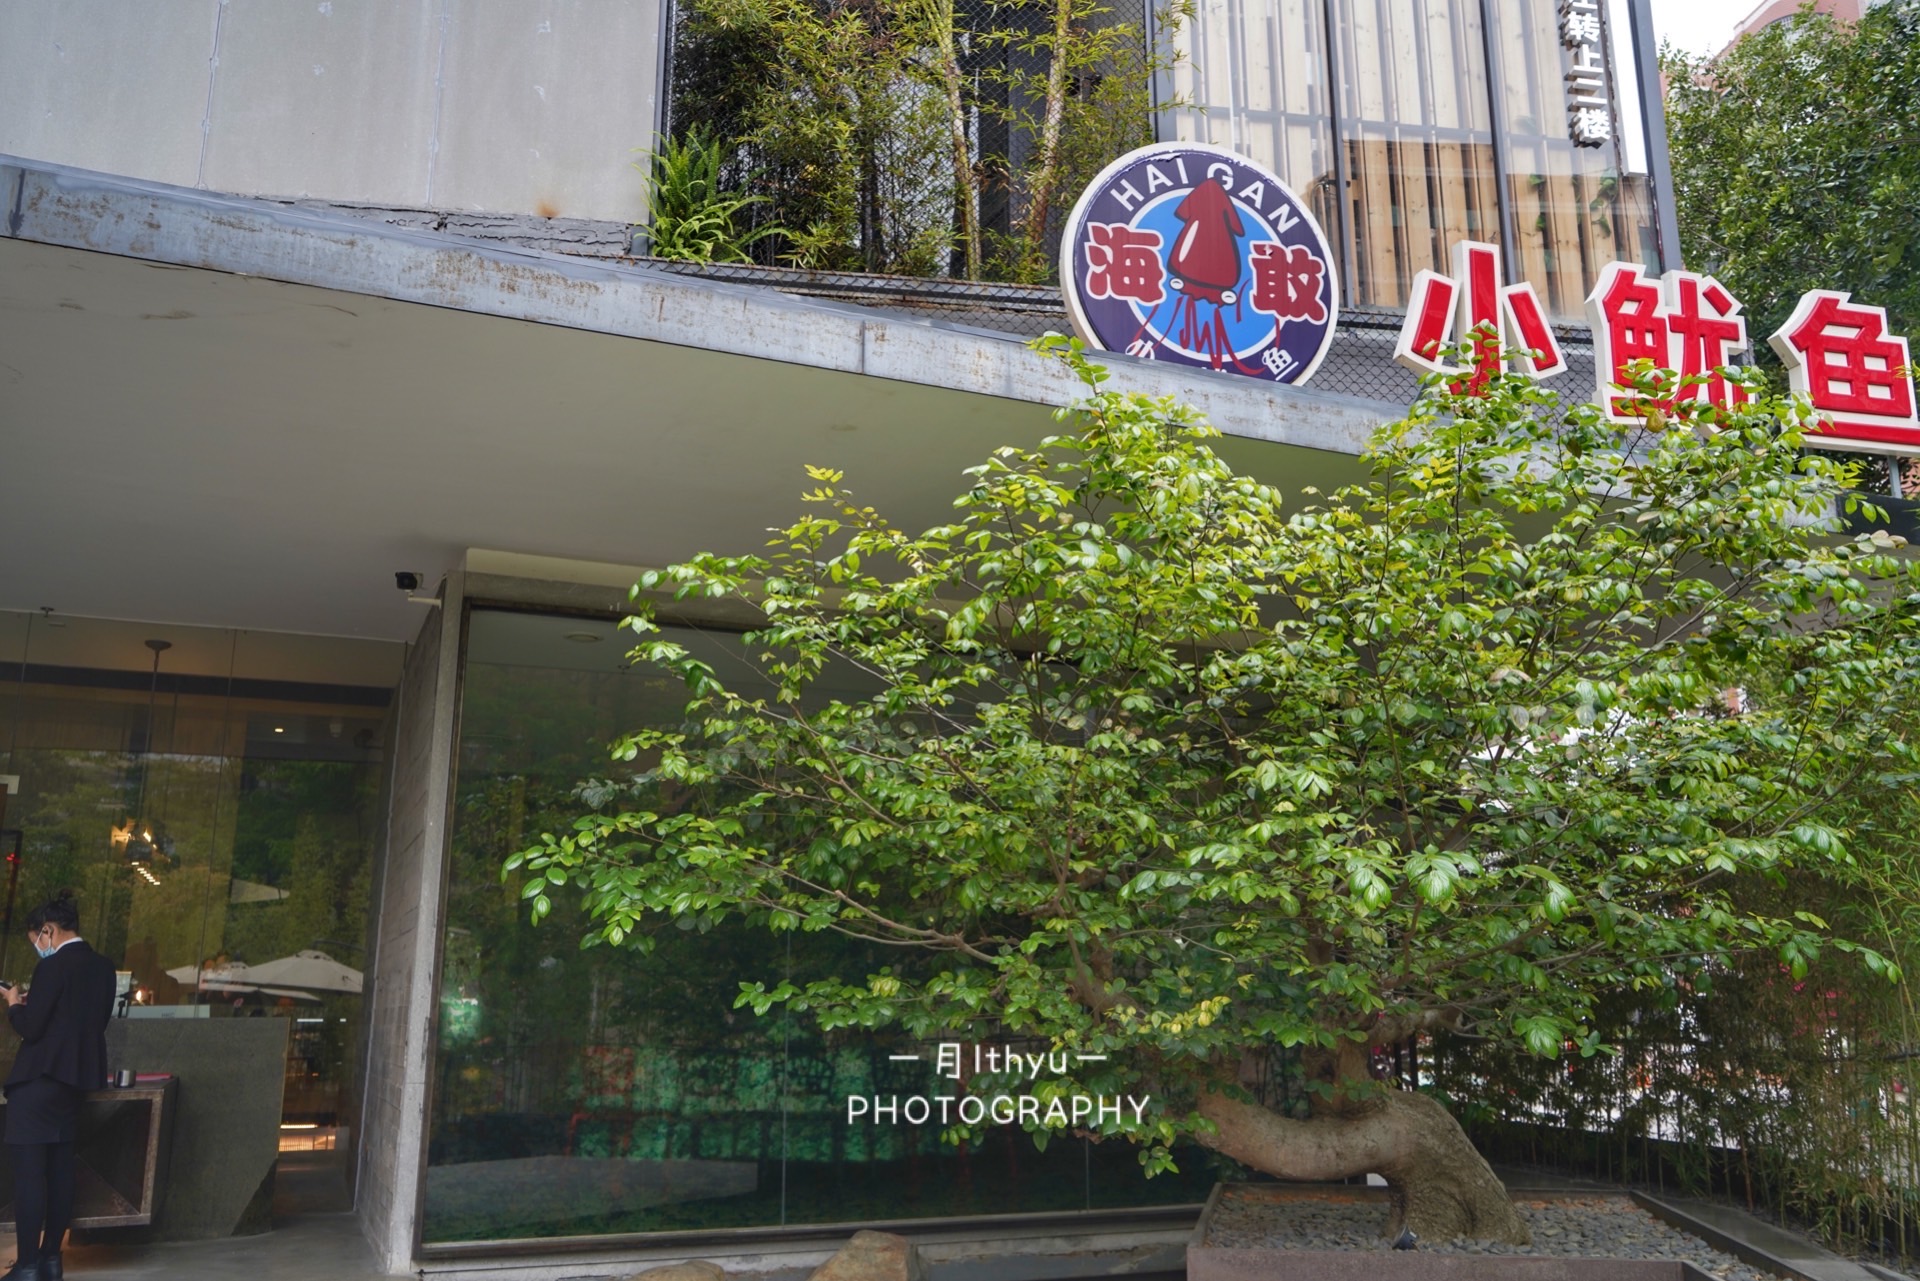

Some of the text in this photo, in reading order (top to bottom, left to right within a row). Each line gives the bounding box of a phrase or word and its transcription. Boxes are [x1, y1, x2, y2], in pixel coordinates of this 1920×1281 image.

[1566, 0, 1611, 142] 转上二楼
[1109, 160, 1301, 235] HAI GAN
[1396, 242, 1920, 452] 小鱿鱼
